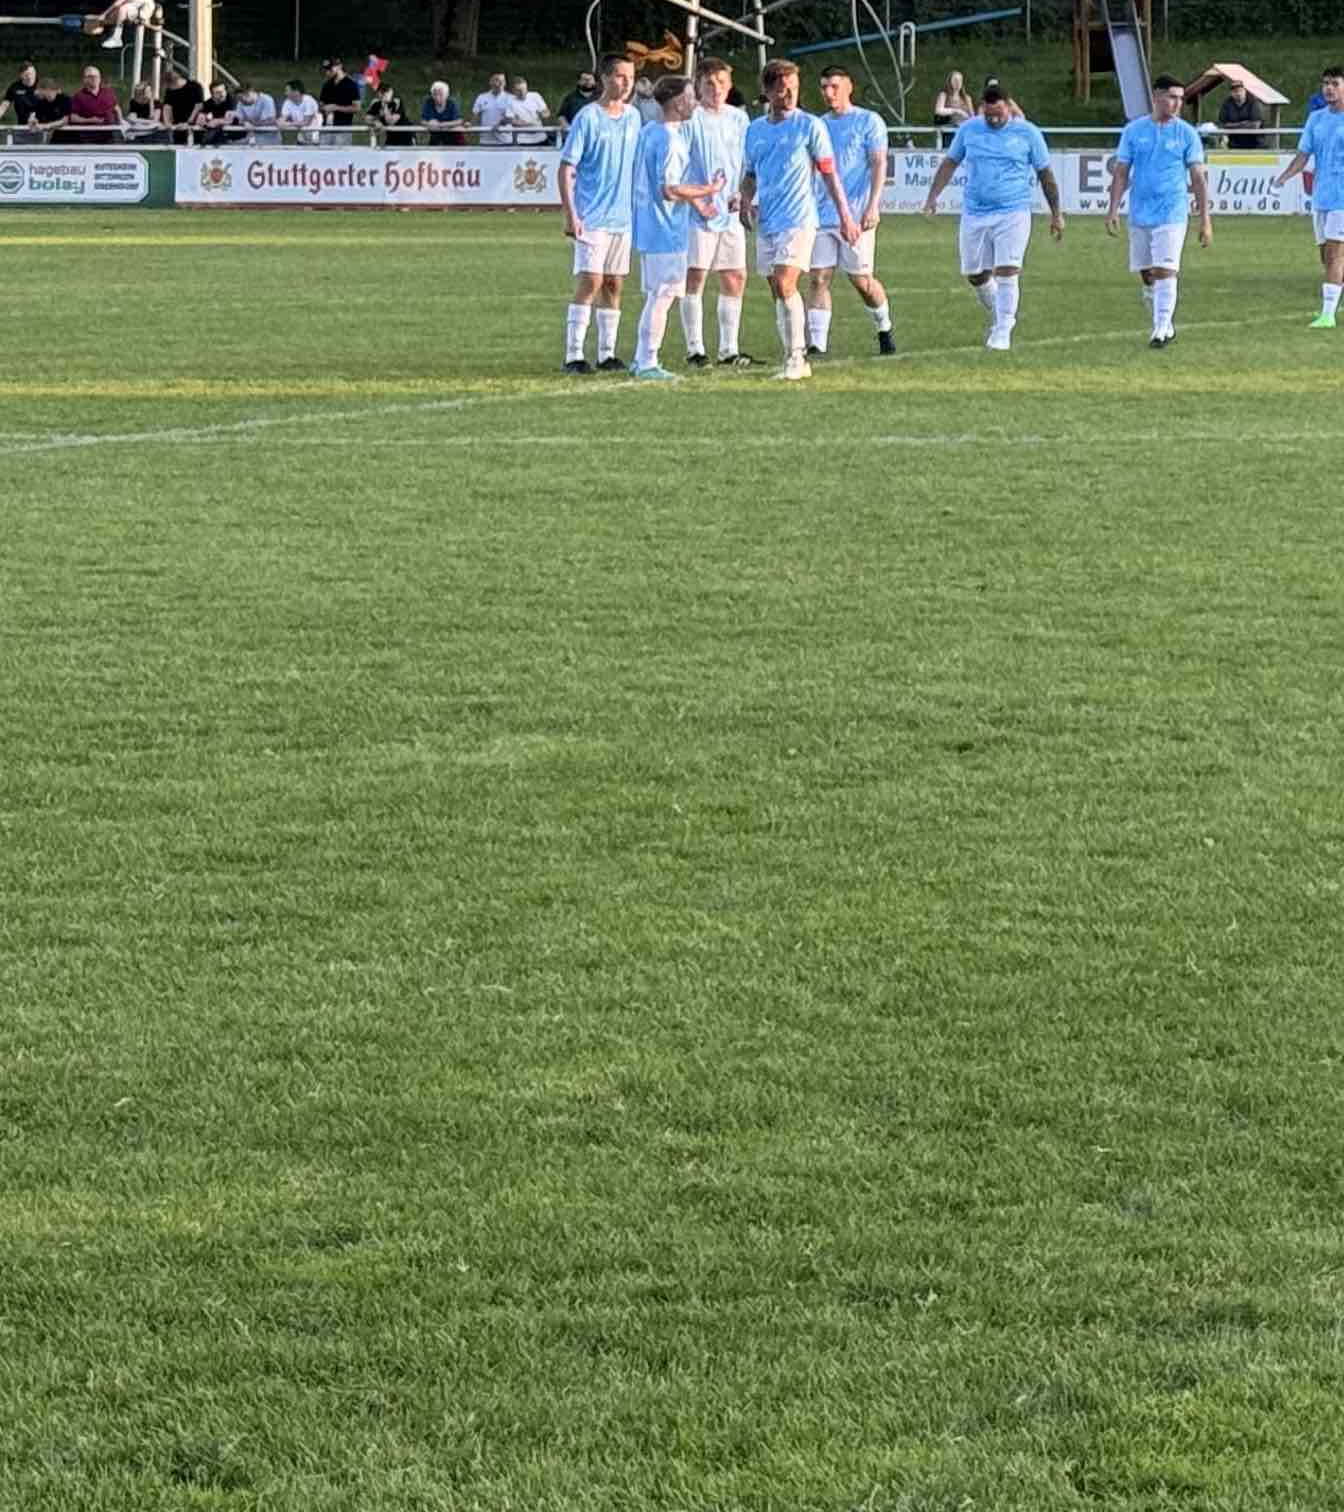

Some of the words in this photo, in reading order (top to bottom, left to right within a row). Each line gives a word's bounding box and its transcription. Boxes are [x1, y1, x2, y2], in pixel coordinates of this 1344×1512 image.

[29, 177, 85, 194] bolay
[247, 160, 378, 195] Stuttgarter
[384, 160, 481, 195] Hofbräu
